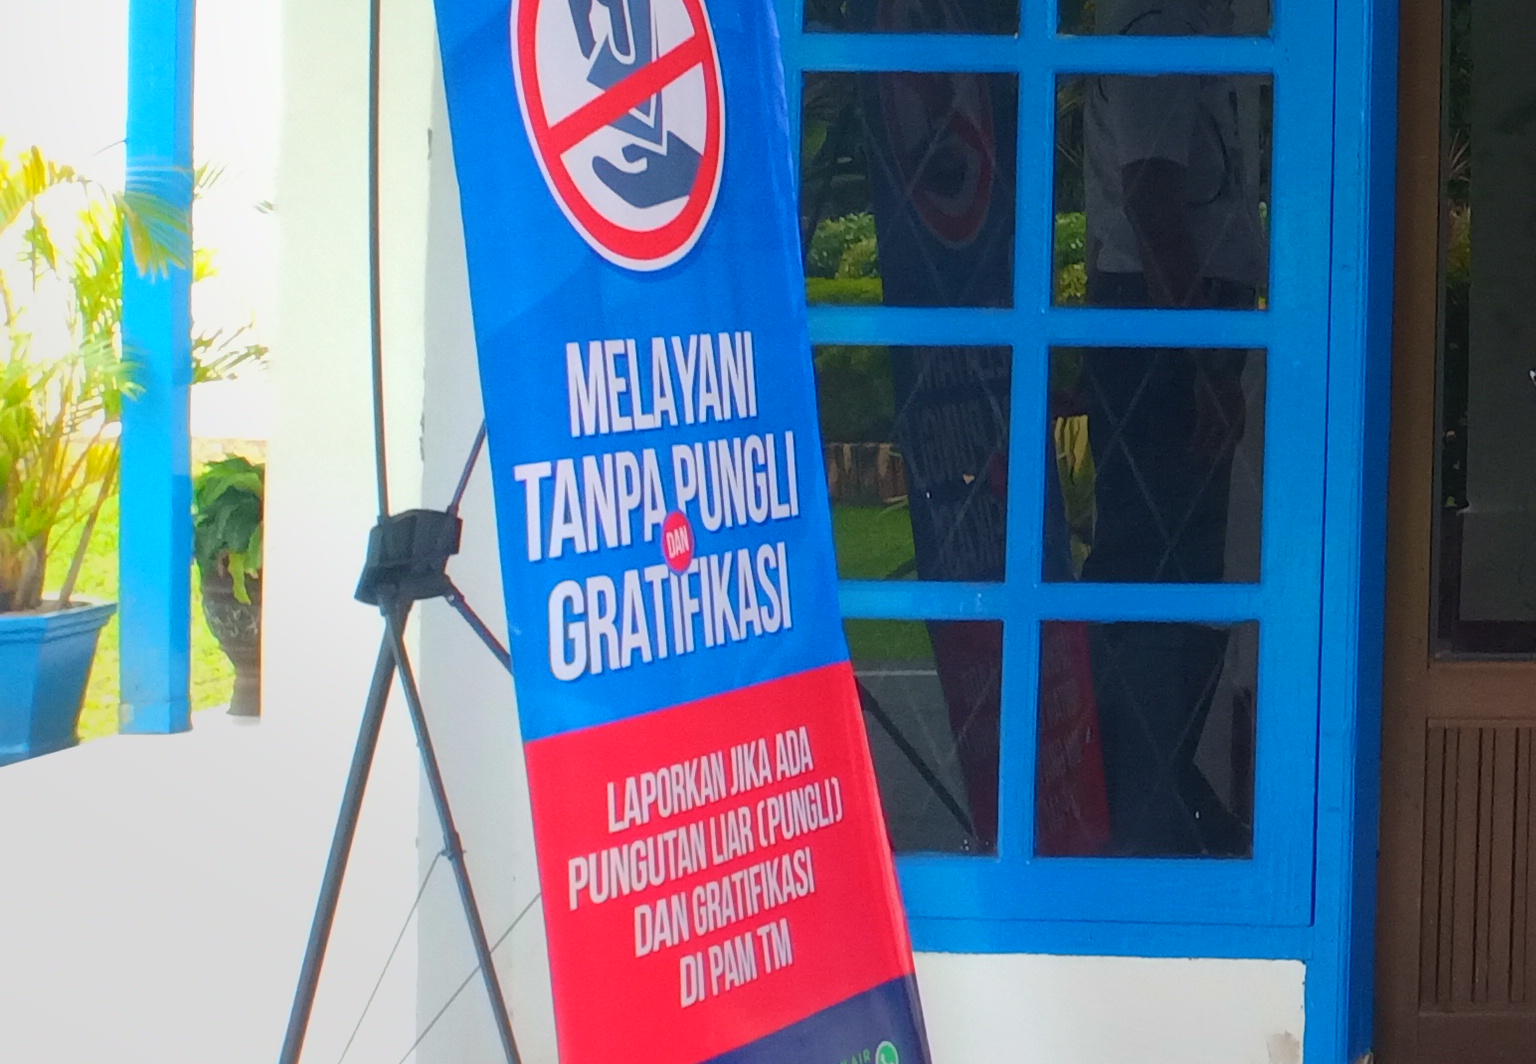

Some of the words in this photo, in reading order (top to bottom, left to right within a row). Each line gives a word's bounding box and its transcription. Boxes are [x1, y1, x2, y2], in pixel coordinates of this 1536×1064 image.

[566, 331, 757, 438] MELAYANI
[514, 448, 666, 562] TANPA
[672, 431, 799, 532] PUNGLI
[665, 525, 689, 560] DAN
[548, 541, 792, 681] GRATIFIKASI
[607, 751, 727, 833] LAPORKAN
[729, 738, 773, 796] JIKA
[775, 726, 813, 780] ADA
[568, 825, 707, 911] PUNGUTAN
[710, 806, 754, 865] LIAR
[756, 776, 844, 847] (PUNGLI)
[634, 891, 690, 958] DAN
[692, 846, 815, 936] GRATIFIKASI
[679, 952, 706, 1008] DI
[709, 932, 758, 996] PAM
[758, 918, 793, 974] TM
